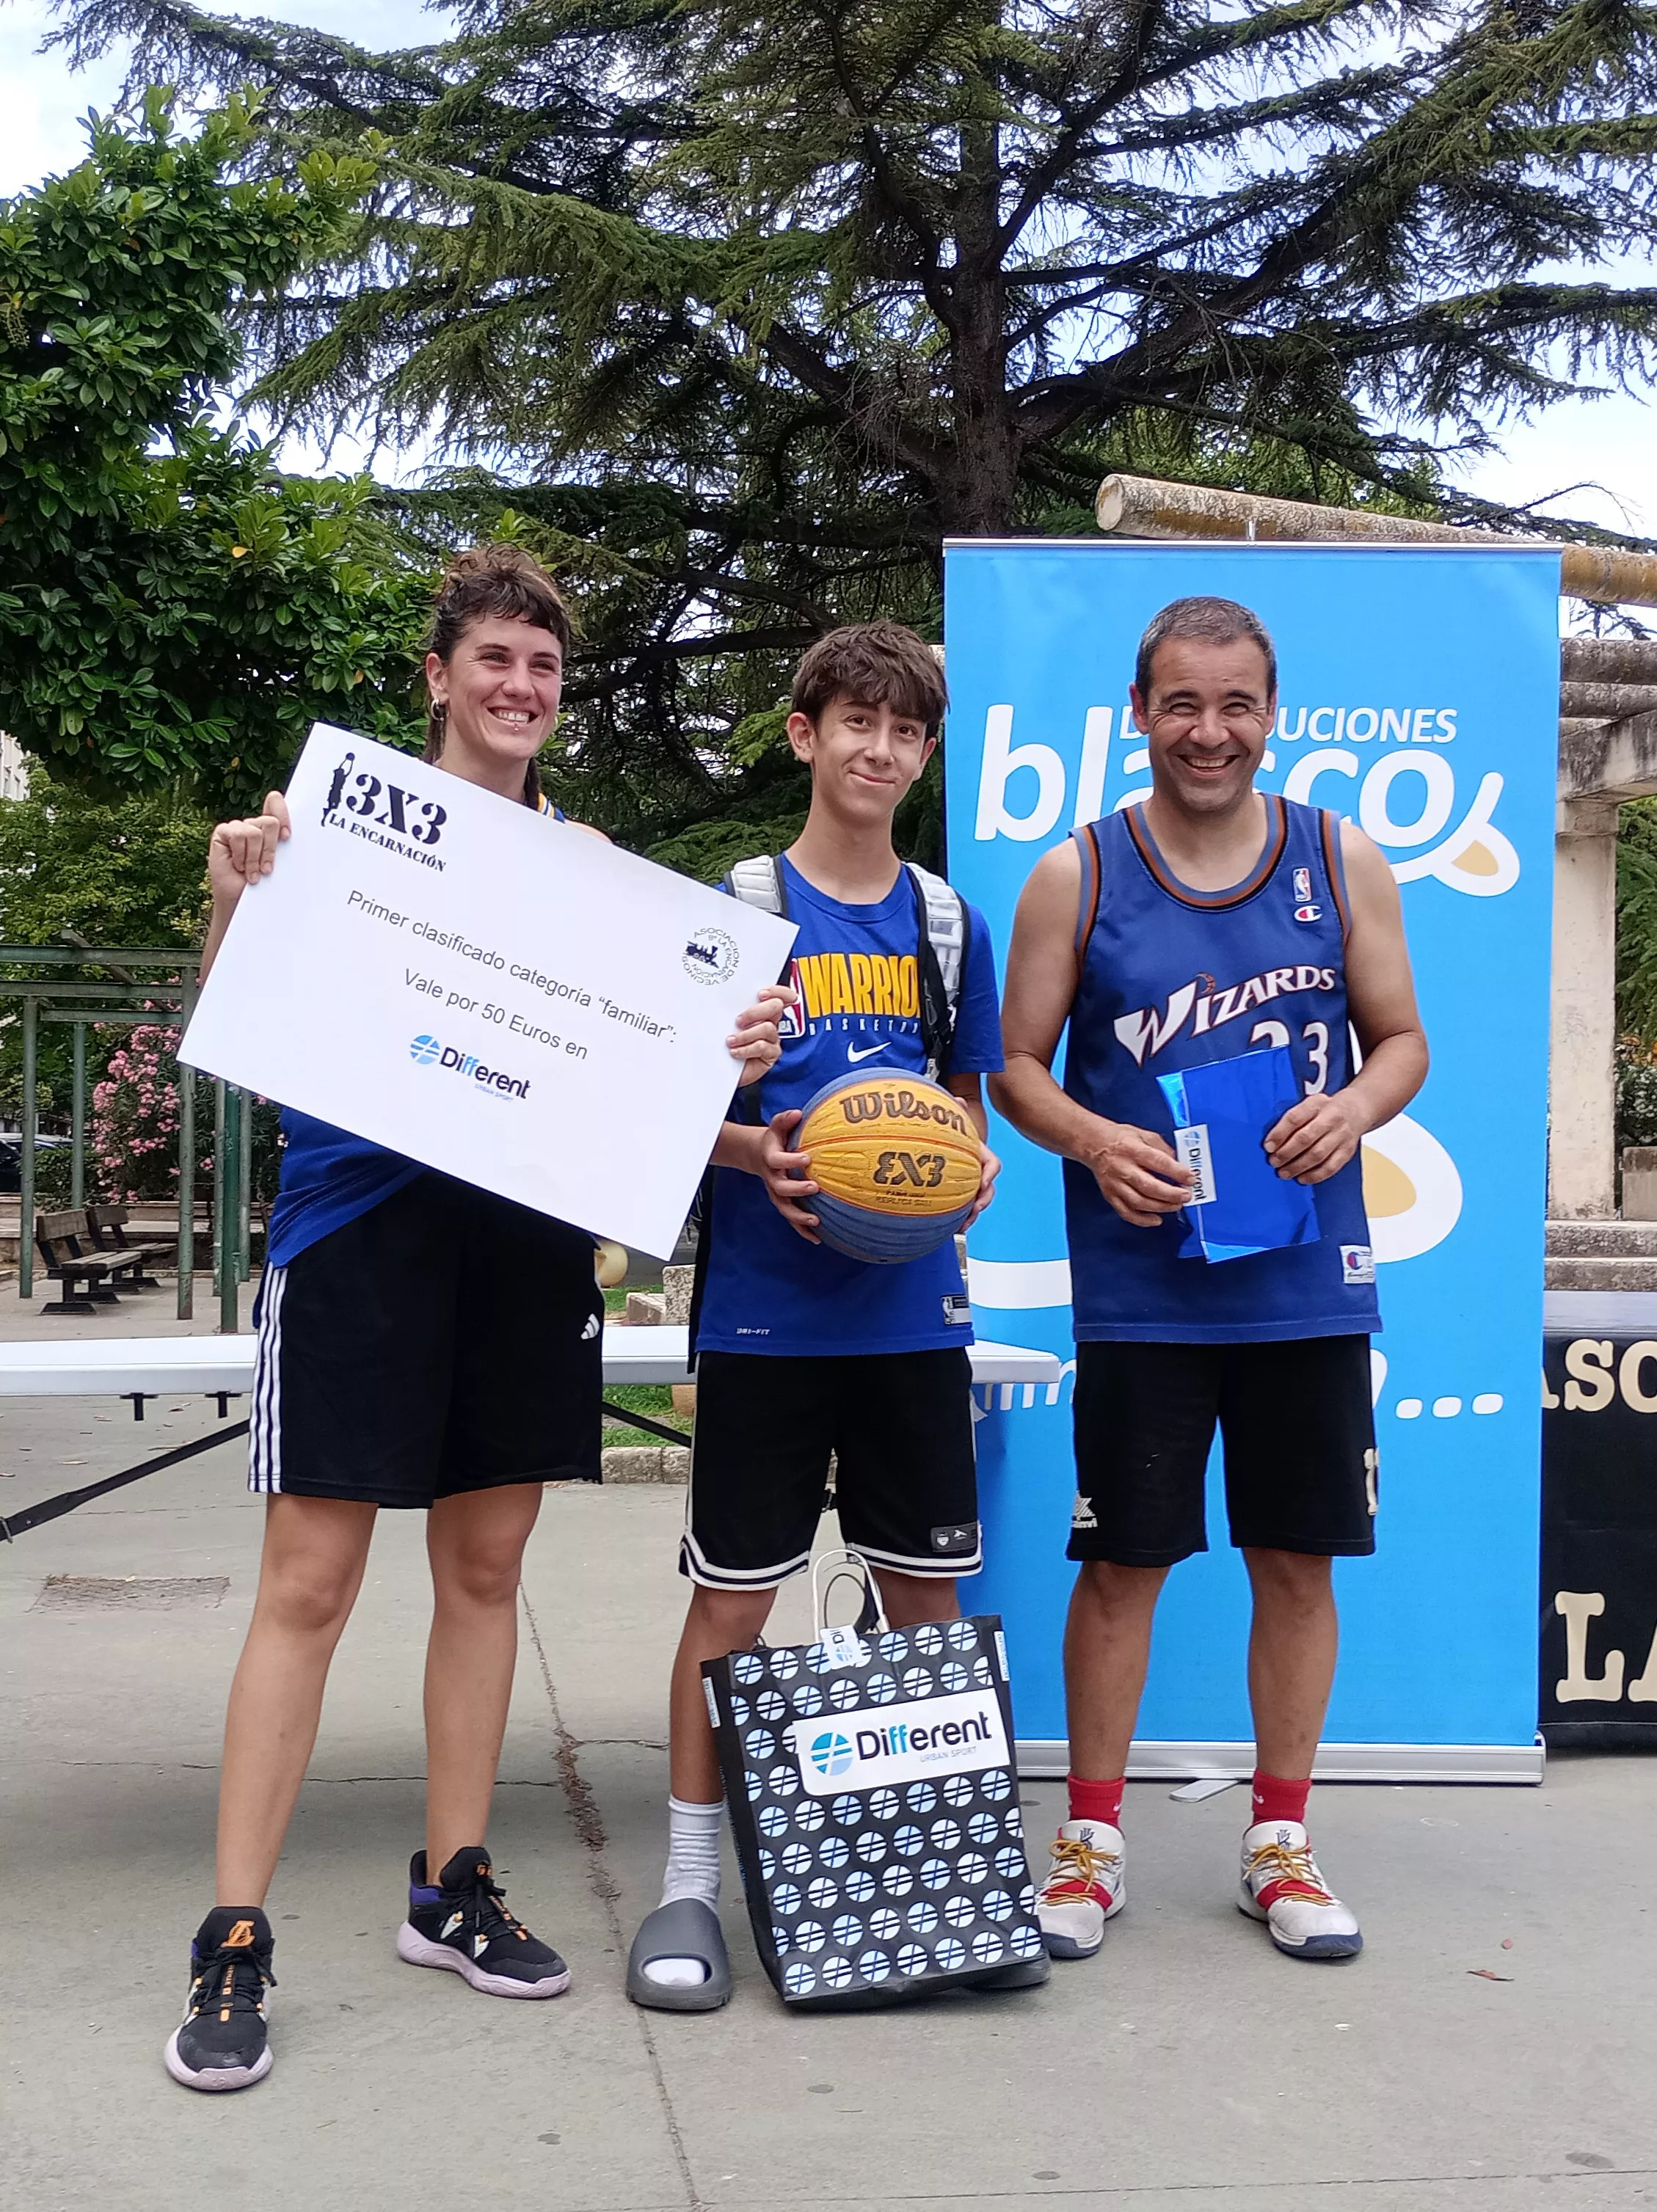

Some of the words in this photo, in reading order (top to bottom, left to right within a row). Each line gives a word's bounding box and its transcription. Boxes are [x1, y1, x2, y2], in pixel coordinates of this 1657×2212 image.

[346, 774, 447, 844] 3X3
[329, 813, 346, 829] LA
[349, 822, 447, 872] ENCARNACIÓN
[347, 890, 409, 927] Primer
[412, 922, 505, 969] clasificado
[510, 964, 591, 1007] categoría
[405, 968, 443, 999] Vale
[445, 992, 479, 1013] por
[481, 1003, 506, 1024] 50
[509, 1014, 561, 1048] Euros
[565, 1041, 589, 1060] en
[798, 952, 920, 1018] WARRIO
[439, 1046, 531, 1100] Different
[840, 1090, 968, 1136] Wilson
[856, 1711, 992, 1761] Different
